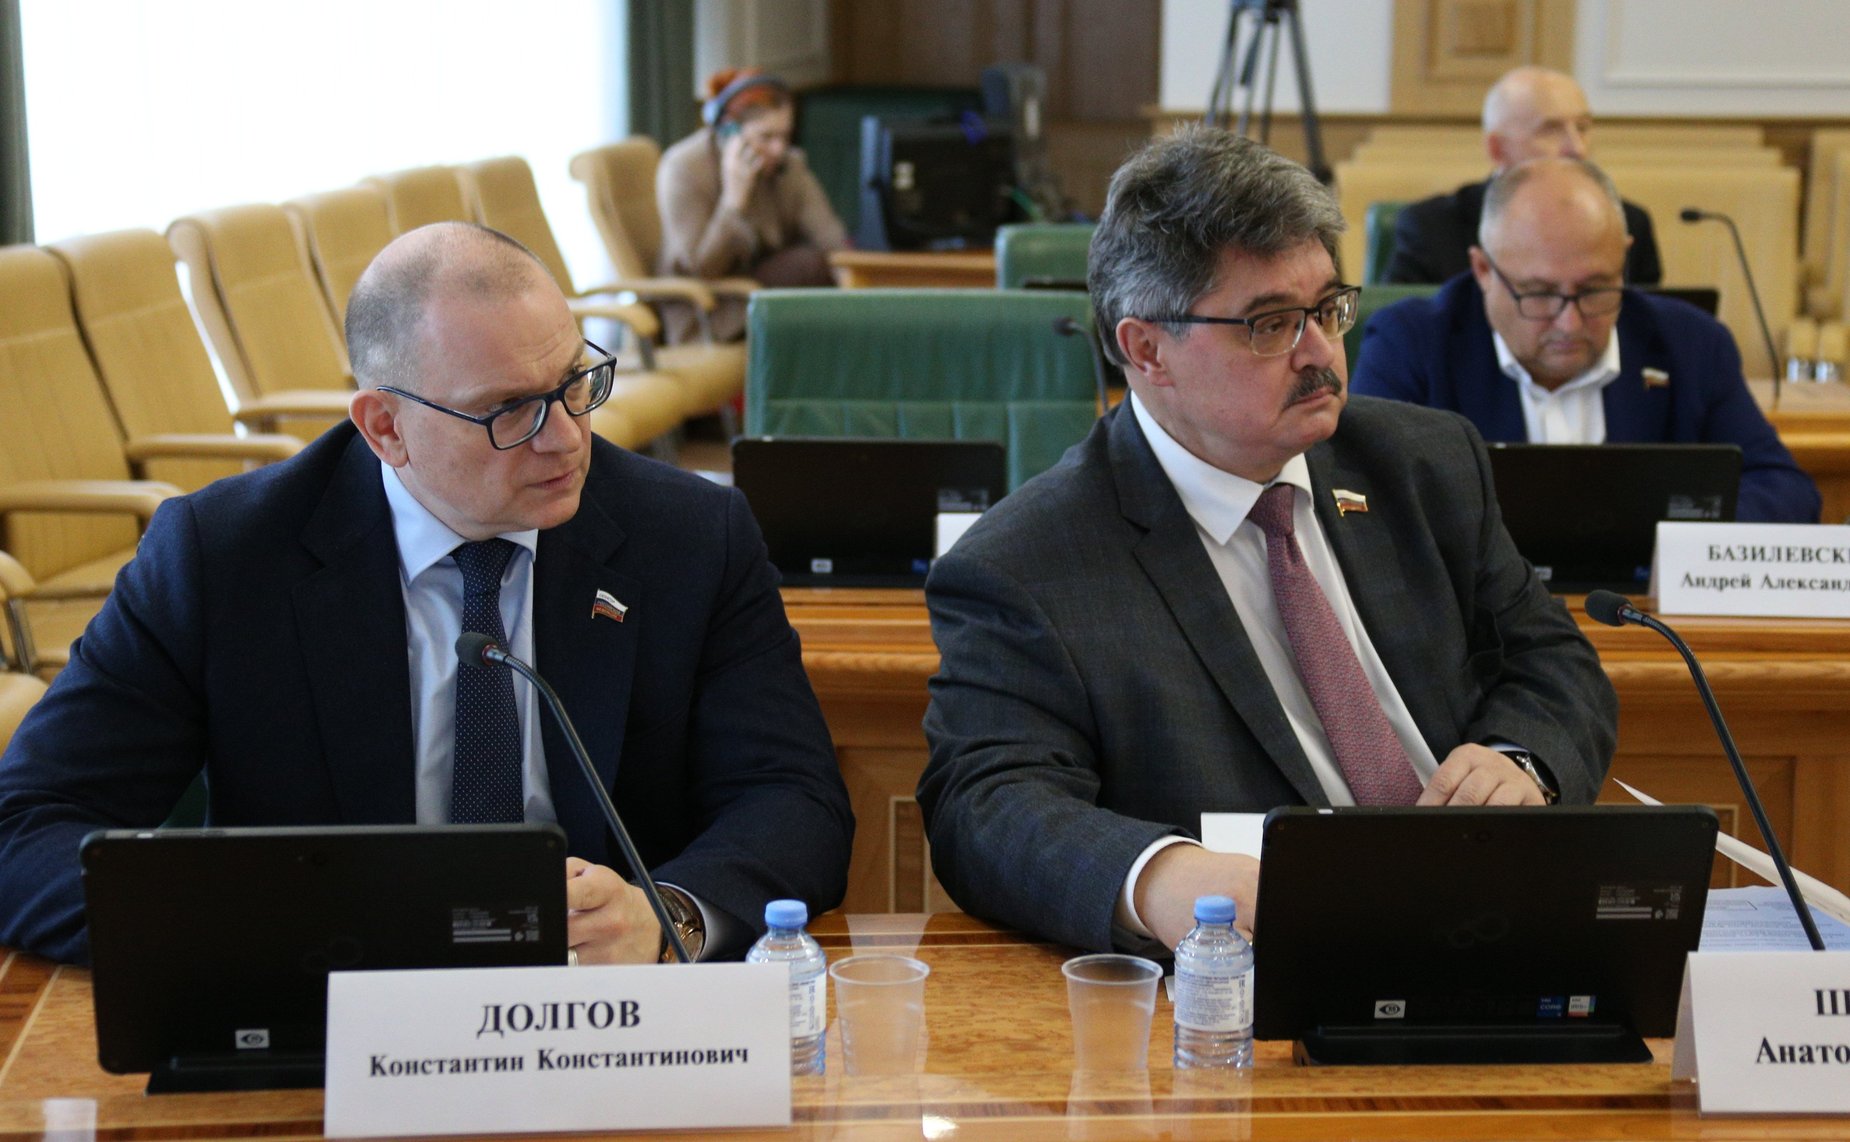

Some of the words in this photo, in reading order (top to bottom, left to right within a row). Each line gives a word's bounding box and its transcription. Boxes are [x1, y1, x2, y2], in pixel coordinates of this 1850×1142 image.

[1708, 545, 1850, 564] БАЗИЛЕВСК
[1682, 572, 1751, 592] Андрей
[476, 1000, 641, 1038] ДОЛГОВ
[369, 1055, 524, 1077] Константин
[537, 1048, 749, 1071] Константинович
[1756, 1037, 1850, 1065] Анато
